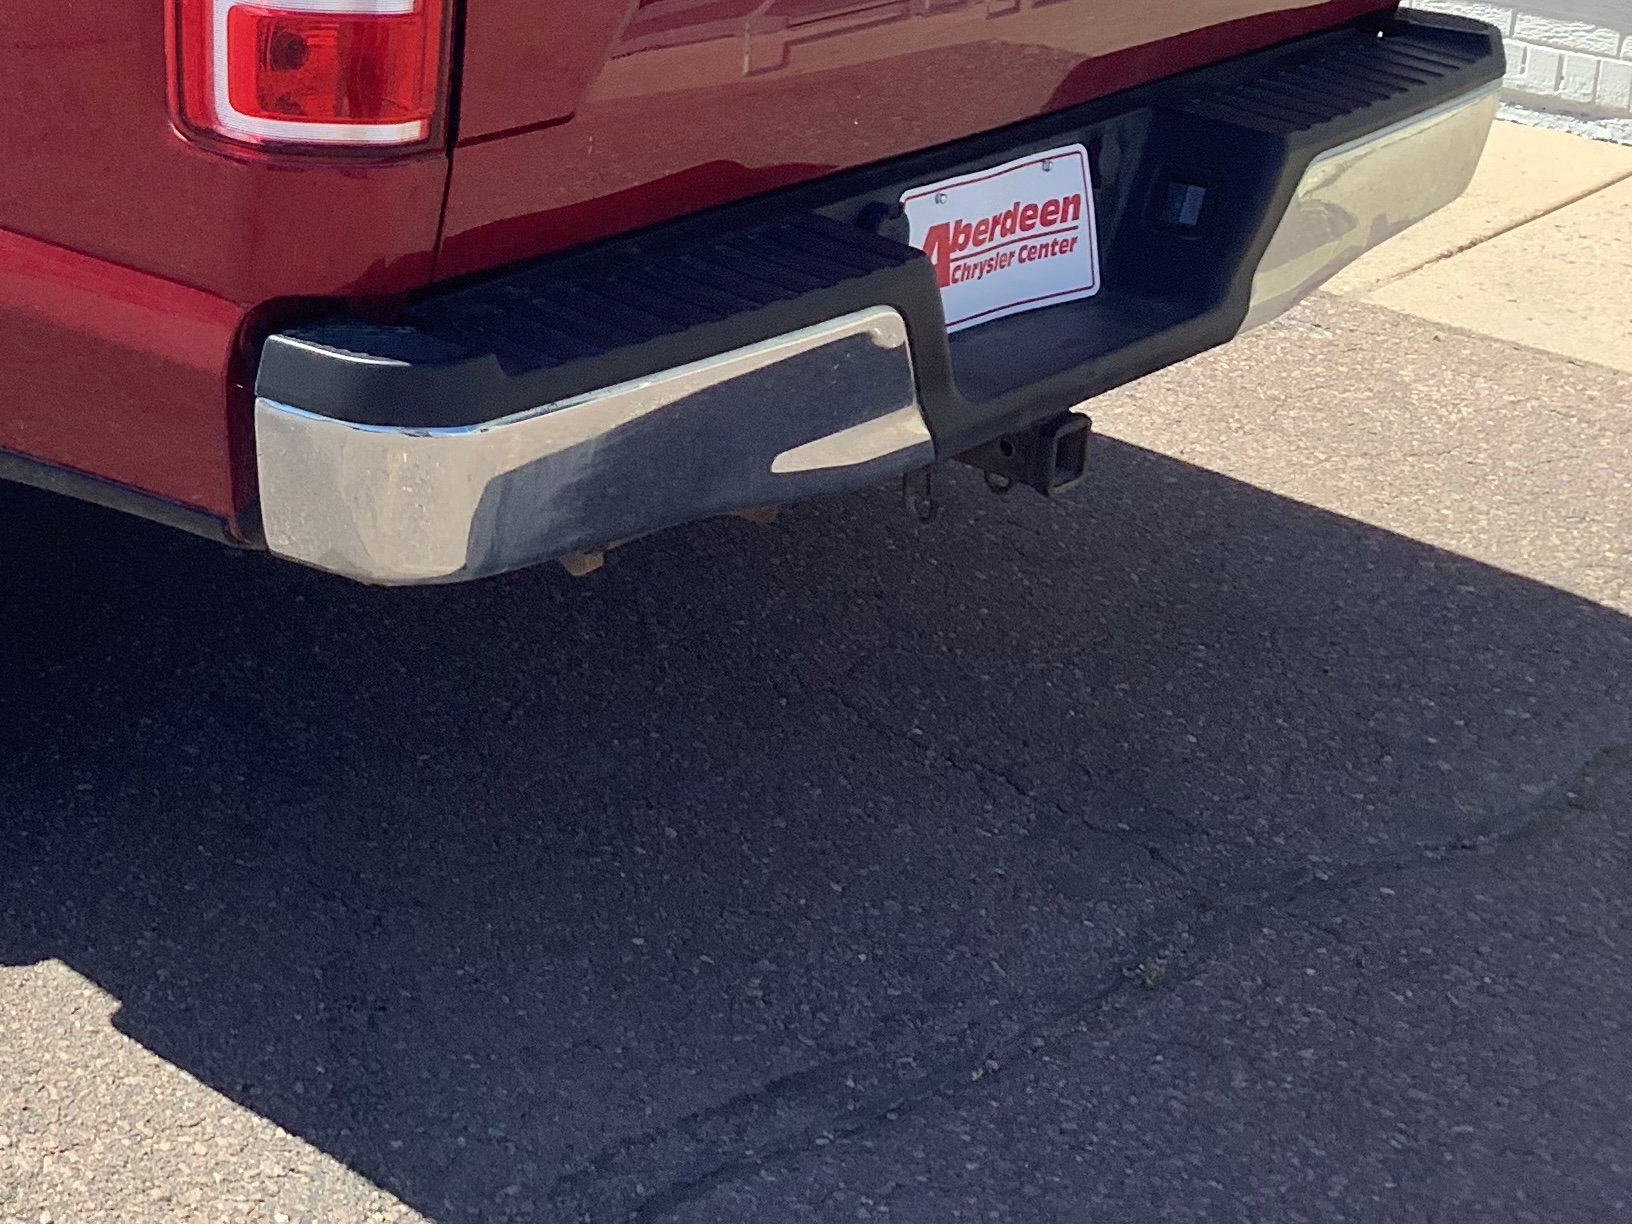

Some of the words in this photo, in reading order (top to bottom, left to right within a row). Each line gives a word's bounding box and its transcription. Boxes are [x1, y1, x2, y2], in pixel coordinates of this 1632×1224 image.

[921, 193, 1081, 288] Aberdeen
[951, 251, 1016, 285] Chrysler
[1018, 235, 1078, 264] Center
